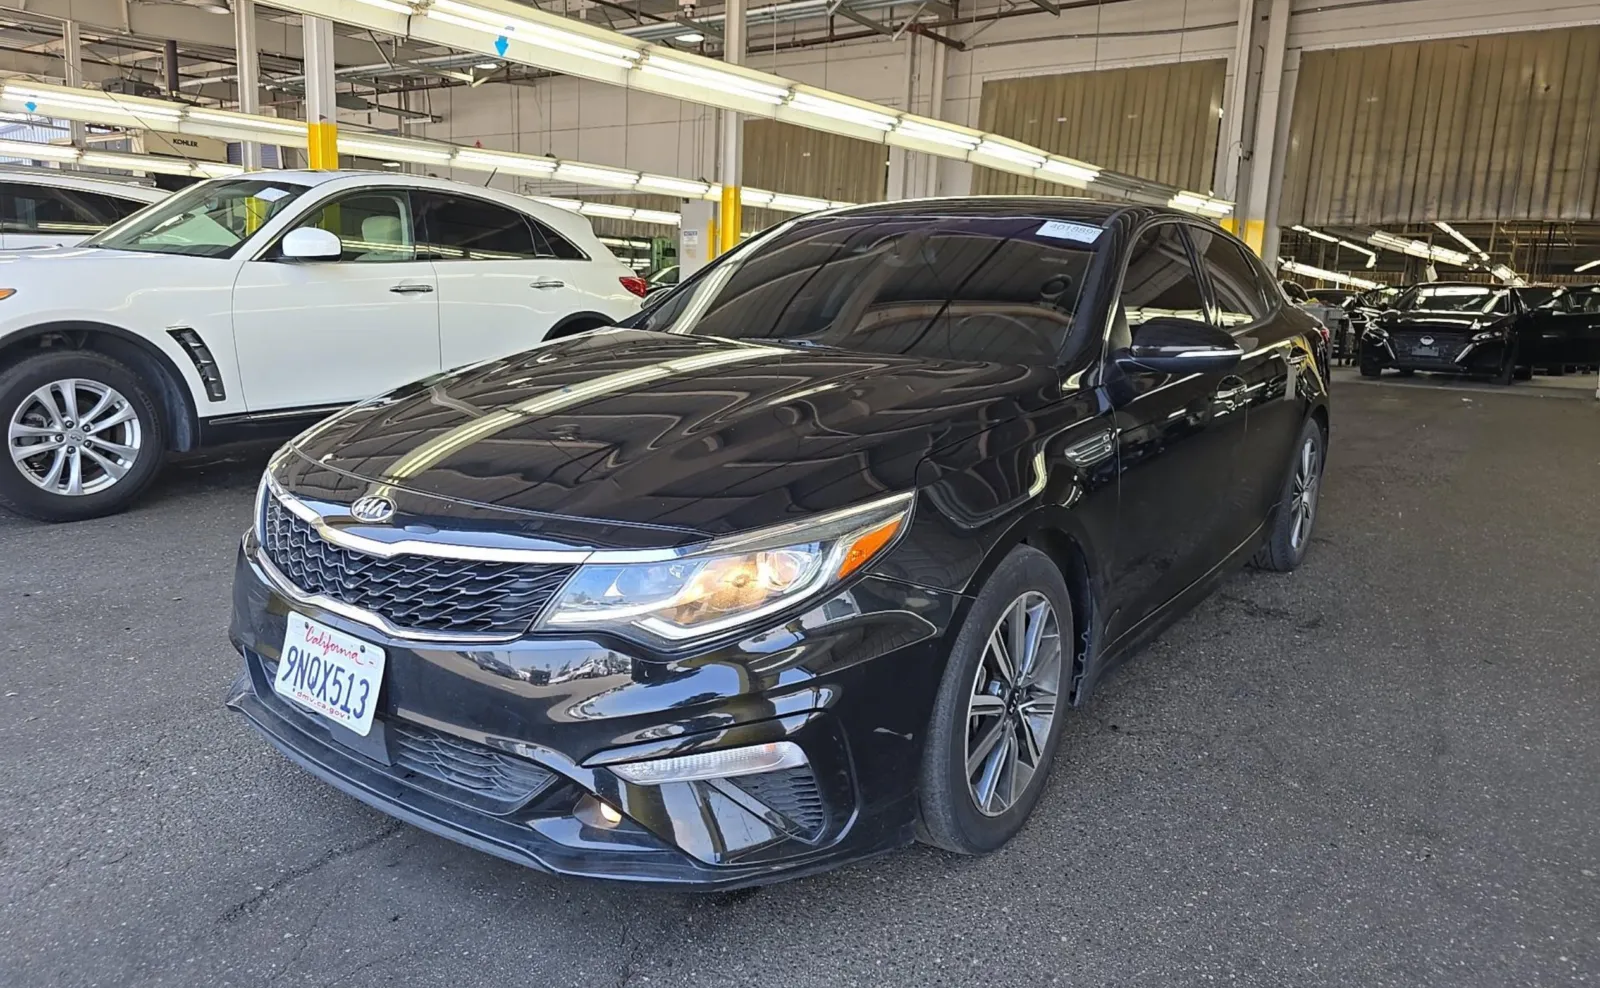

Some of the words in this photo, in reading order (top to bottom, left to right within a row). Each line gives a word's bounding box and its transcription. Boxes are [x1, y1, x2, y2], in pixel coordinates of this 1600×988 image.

[173, 138, 198, 147] KOHLER
[354, 498, 388, 517] KIA
[304, 626, 363, 666] California
[281, 645, 370, 719] 9NQX513
[296, 691, 346, 720] dmv.ca.gov
